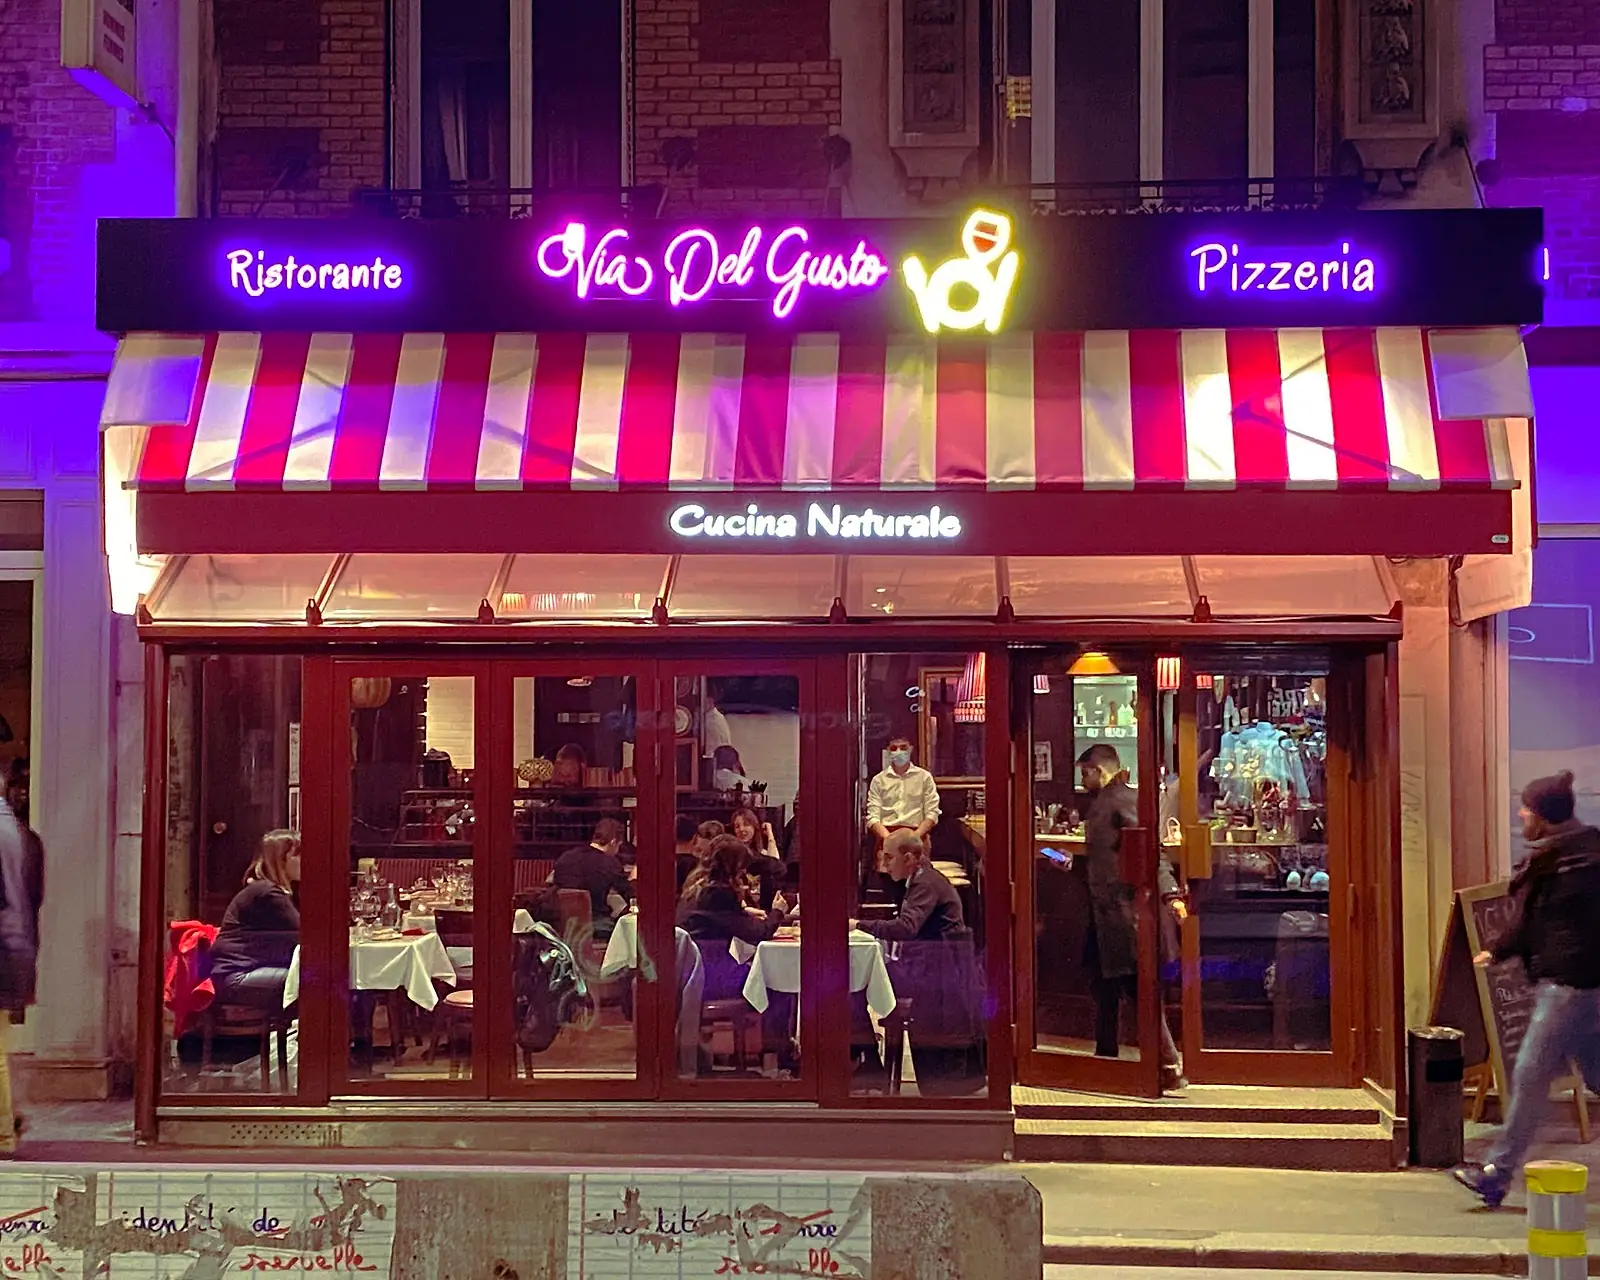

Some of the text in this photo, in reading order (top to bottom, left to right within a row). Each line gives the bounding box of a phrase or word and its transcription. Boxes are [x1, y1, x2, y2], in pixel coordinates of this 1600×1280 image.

[227, 250, 402, 296] Ristorante
[537, 222, 888, 318] Via Del Gusto
[1190, 242, 1375, 291] Pizzeria
[670, 502, 961, 538] Cucina Naturale
[252, 1207, 281, 1231] de
